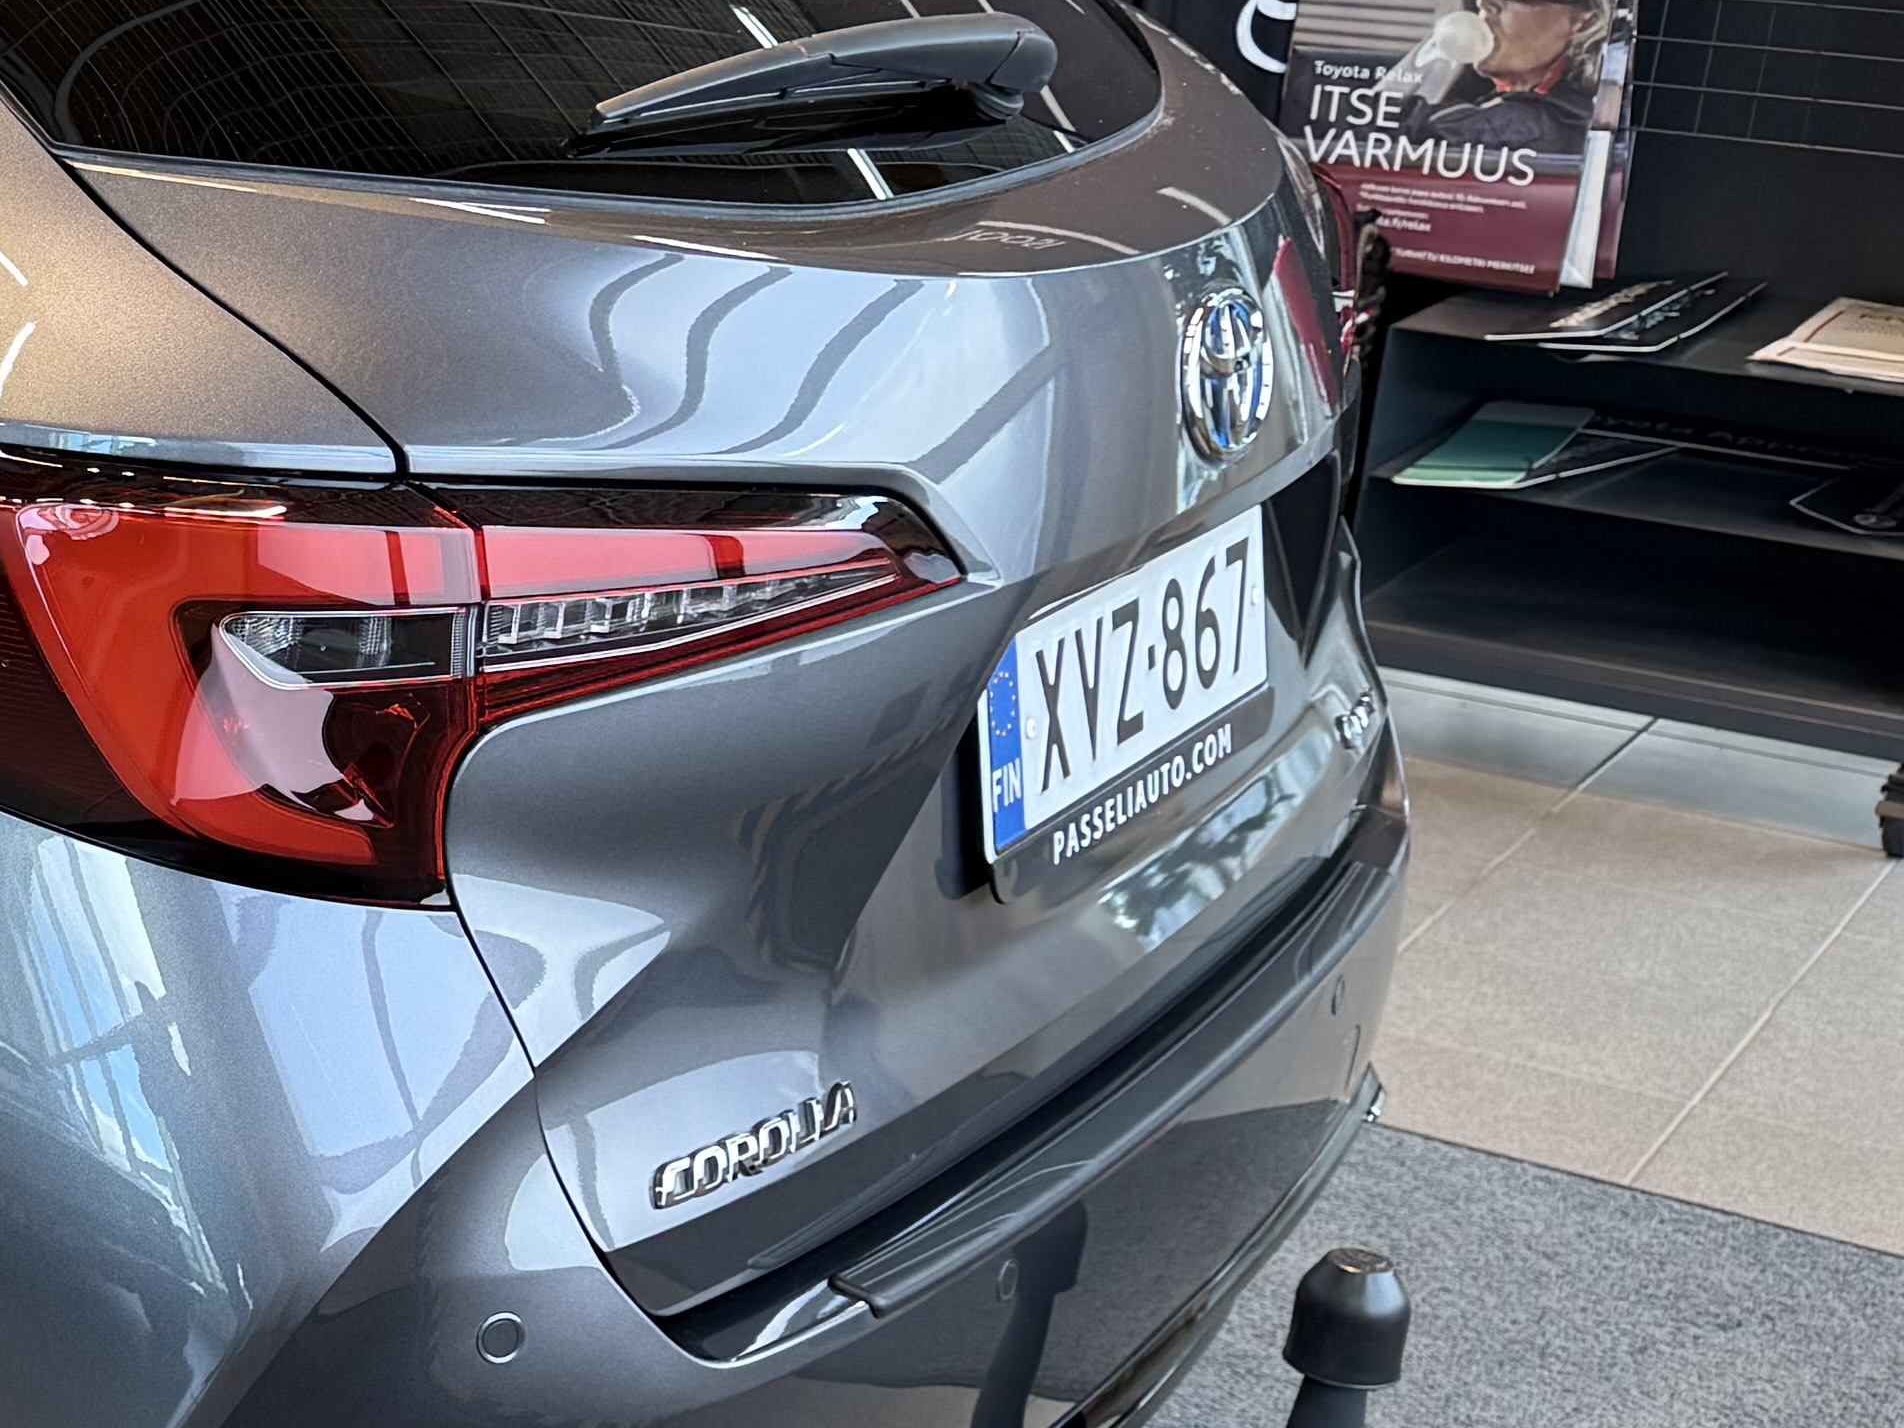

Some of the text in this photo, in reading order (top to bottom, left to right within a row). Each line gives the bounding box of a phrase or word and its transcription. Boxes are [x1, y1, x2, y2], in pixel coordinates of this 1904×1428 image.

[1314, 60, 1370, 80] Toyota
[1309, 83, 1404, 129] ITSE
[1303, 125, 1538, 187] VARMUUS
[1034, 536, 1250, 795] XVZ-867
[992, 757, 1023, 812] FIN
[1052, 723, 1233, 865] PASSELIAUTO.COM
